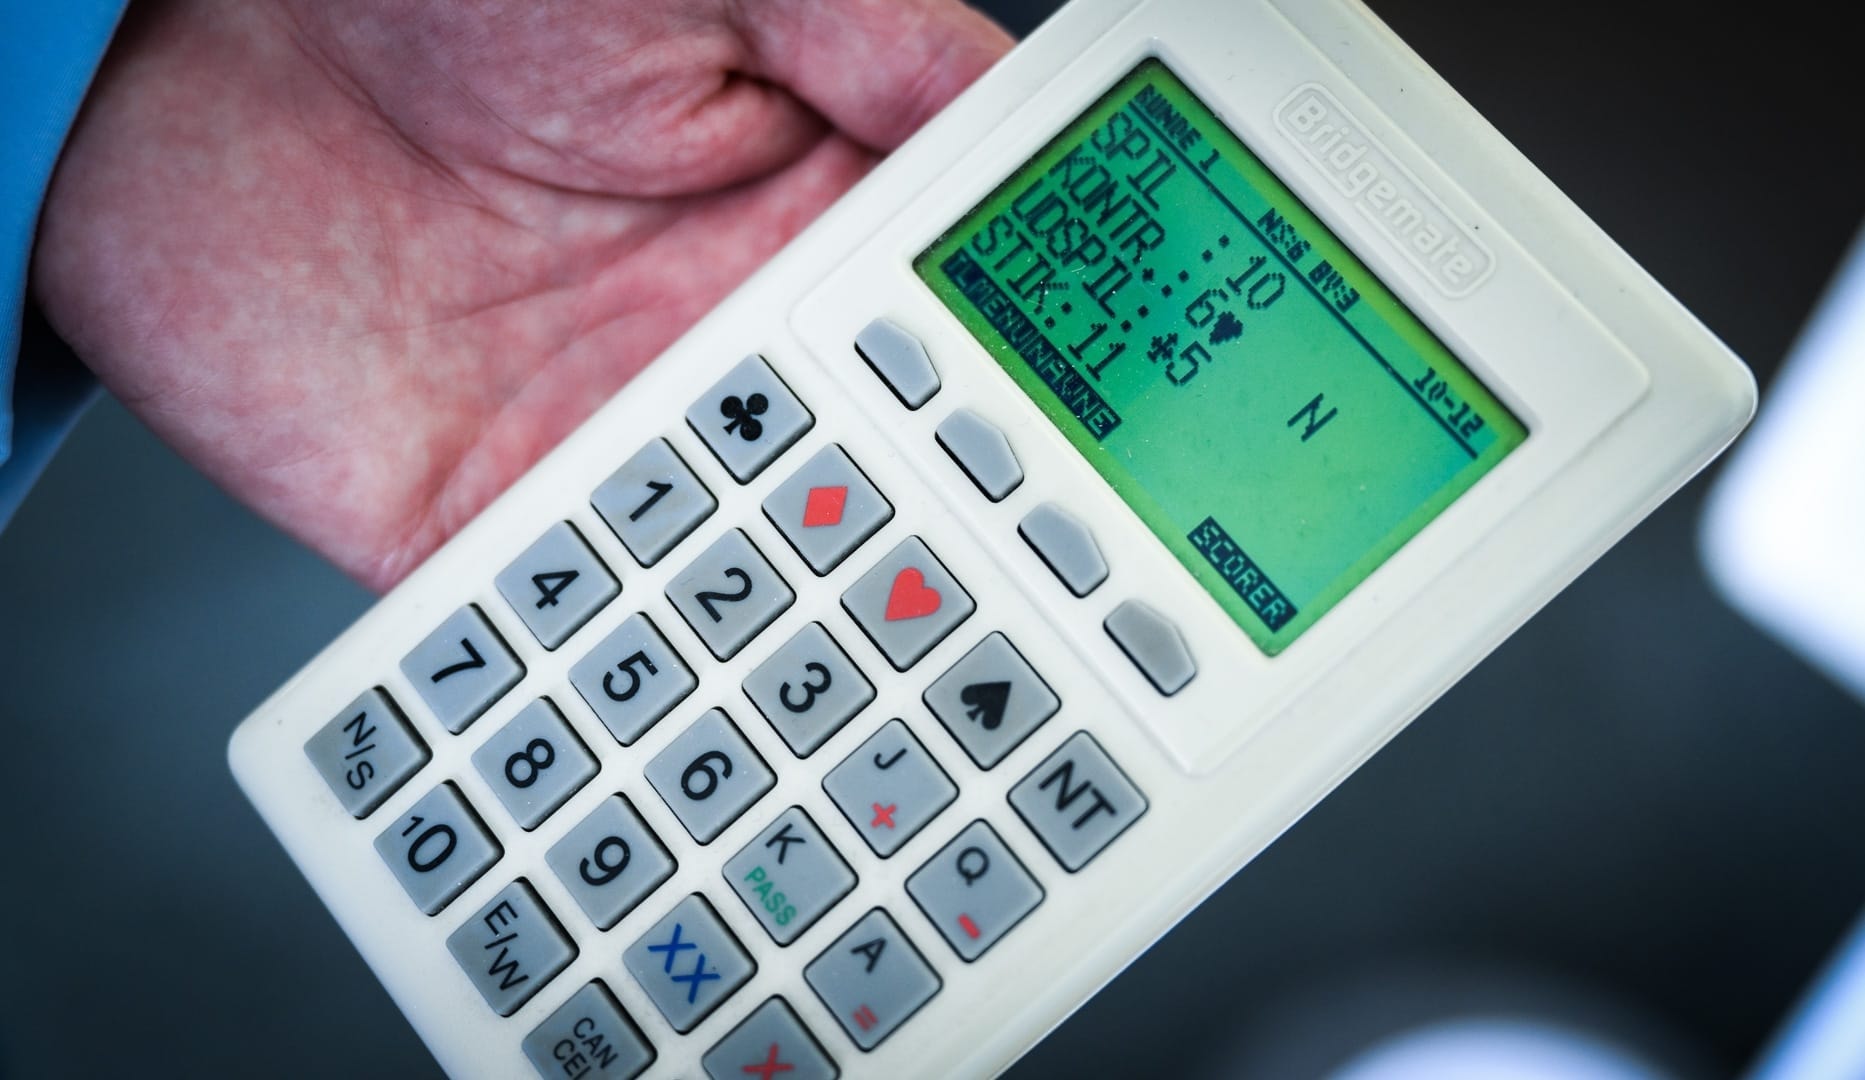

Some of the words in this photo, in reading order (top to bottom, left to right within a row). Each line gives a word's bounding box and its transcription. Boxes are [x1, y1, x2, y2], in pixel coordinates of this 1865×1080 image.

[1199, 149, 1220, 173] 1
[1090, 112, 1176, 211] SPIL
[1225, 255, 1286, 310] 10
[1288, 95, 1473, 284] Bridgemate
[1067, 322, 1126, 382] 11
[1287, 393, 1338, 442] N
[1413, 366, 1485, 439] 10-12
[629, 480, 674, 523] 1
[531, 569, 580, 610] 4
[694, 567, 753, 624] 2
[1193, 525, 1288, 625] SCORER
[431, 637, 487, 683] 7
[602, 650, 659, 702] 5
[779, 662, 832, 714] 3
[343, 711, 377, 791] N/S
[504, 738, 556, 789] 8
[680, 750, 733, 800] 6
[873, 747, 908, 770] J
[1038, 759, 1118, 830] NT
[401, 815, 458, 874] 10
[579, 835, 632, 887] 9
[765, 822, 806, 865] K
[956, 845, 991, 886] Q
[744, 865, 798, 927] PASS
[484, 901, 529, 991] E/W
[647, 922, 721, 1005] XX
[851, 936, 887, 974] A
[573, 1017, 619, 1070] CAN
